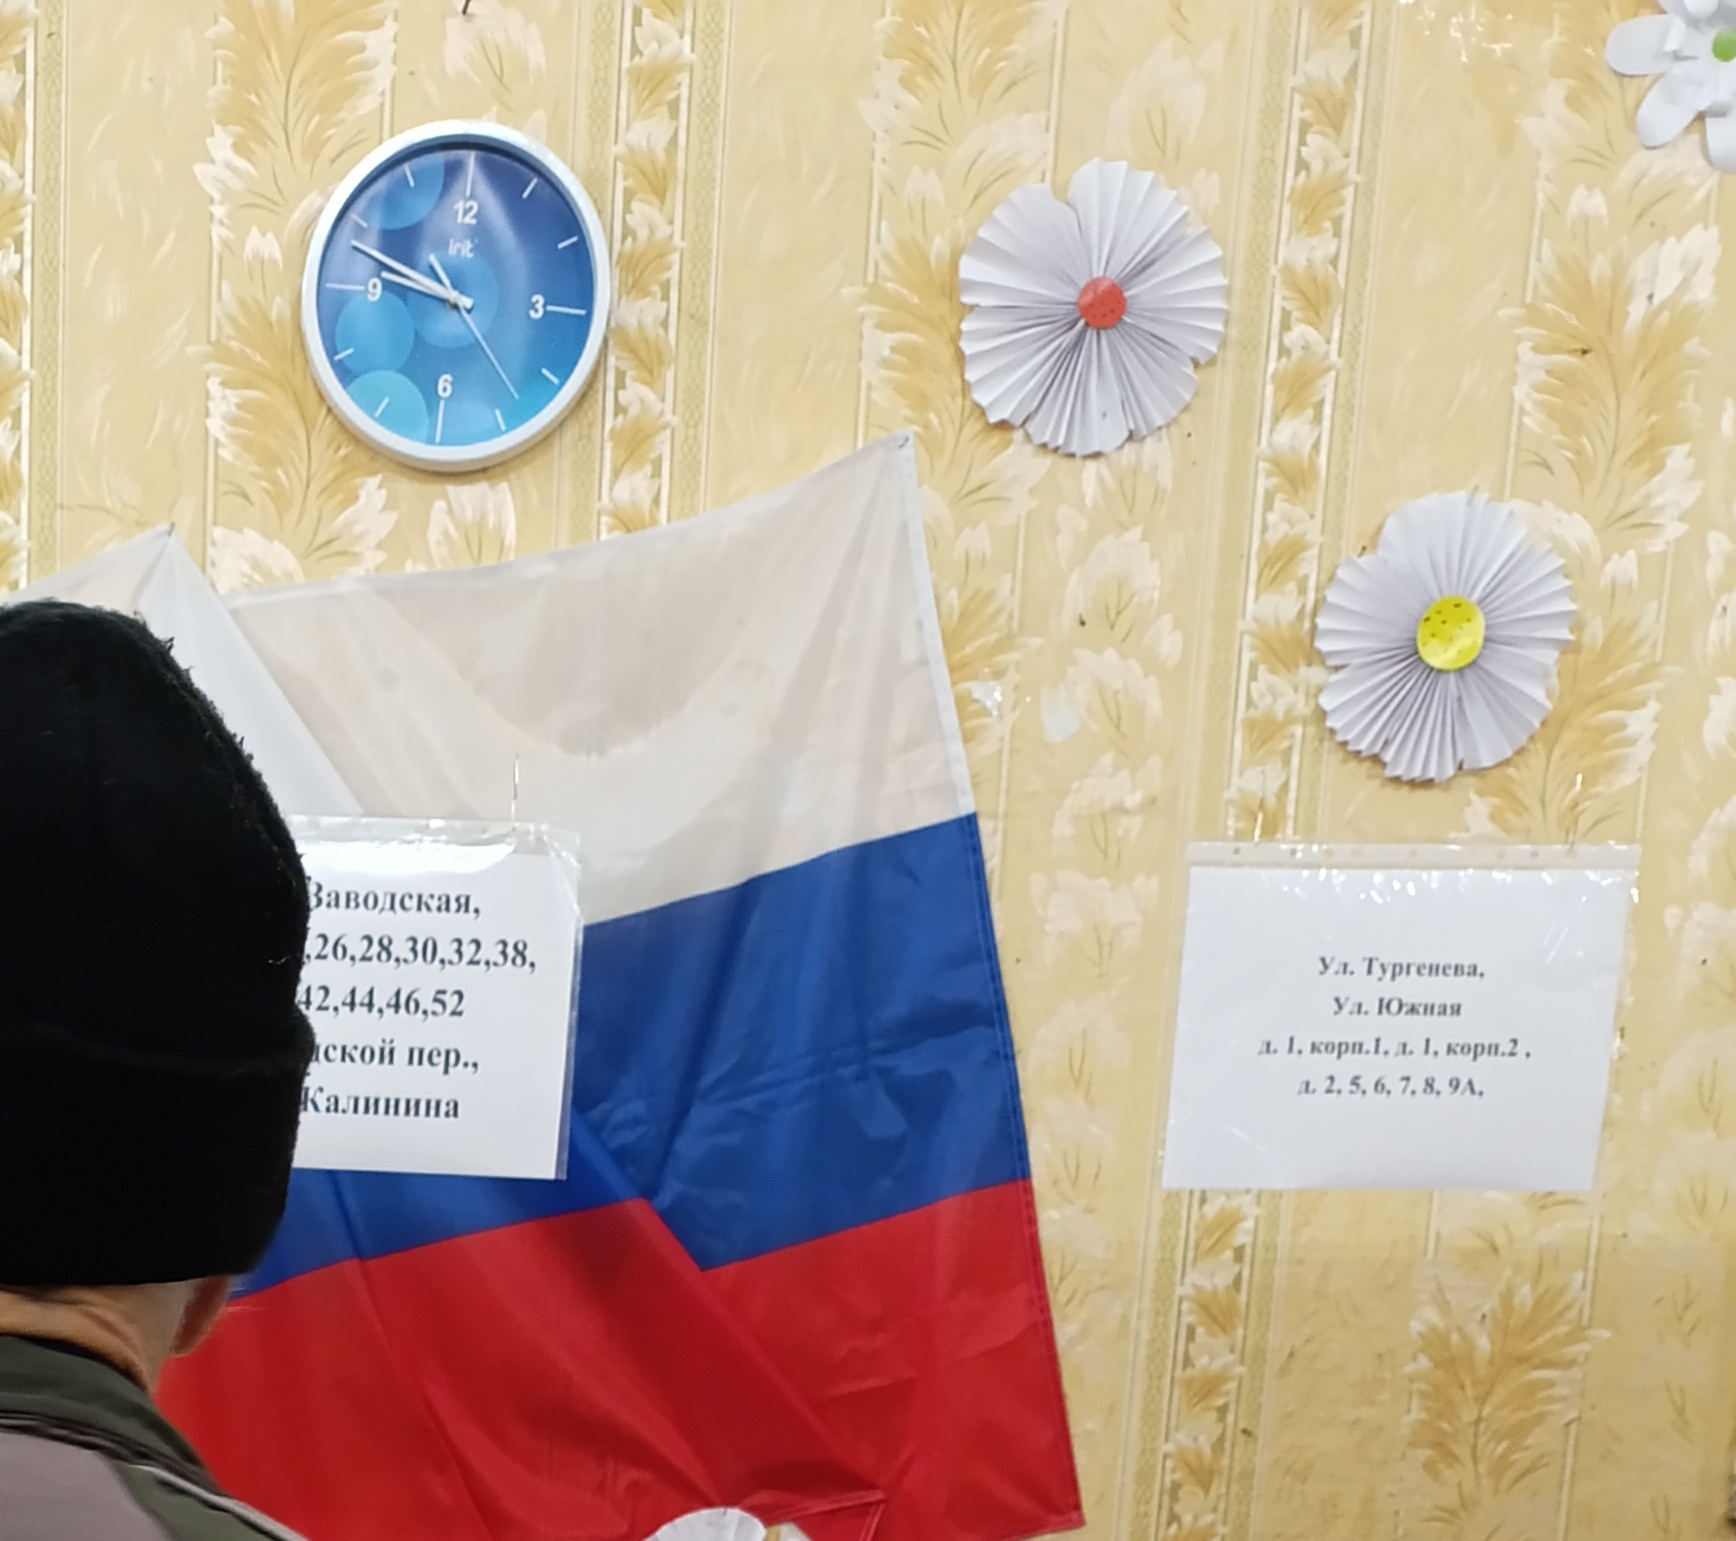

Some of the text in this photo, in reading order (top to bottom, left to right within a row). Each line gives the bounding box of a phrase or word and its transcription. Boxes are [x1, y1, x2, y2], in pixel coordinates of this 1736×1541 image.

[453, 200, 479, 225] 12
[366, 278, 383, 302] 9
[529, 294, 546, 320] 3
[437, 373, 454, 399] 6
[407, 1046, 479, 1076] пер.,
[300, 1086, 459, 1119] Калинина
